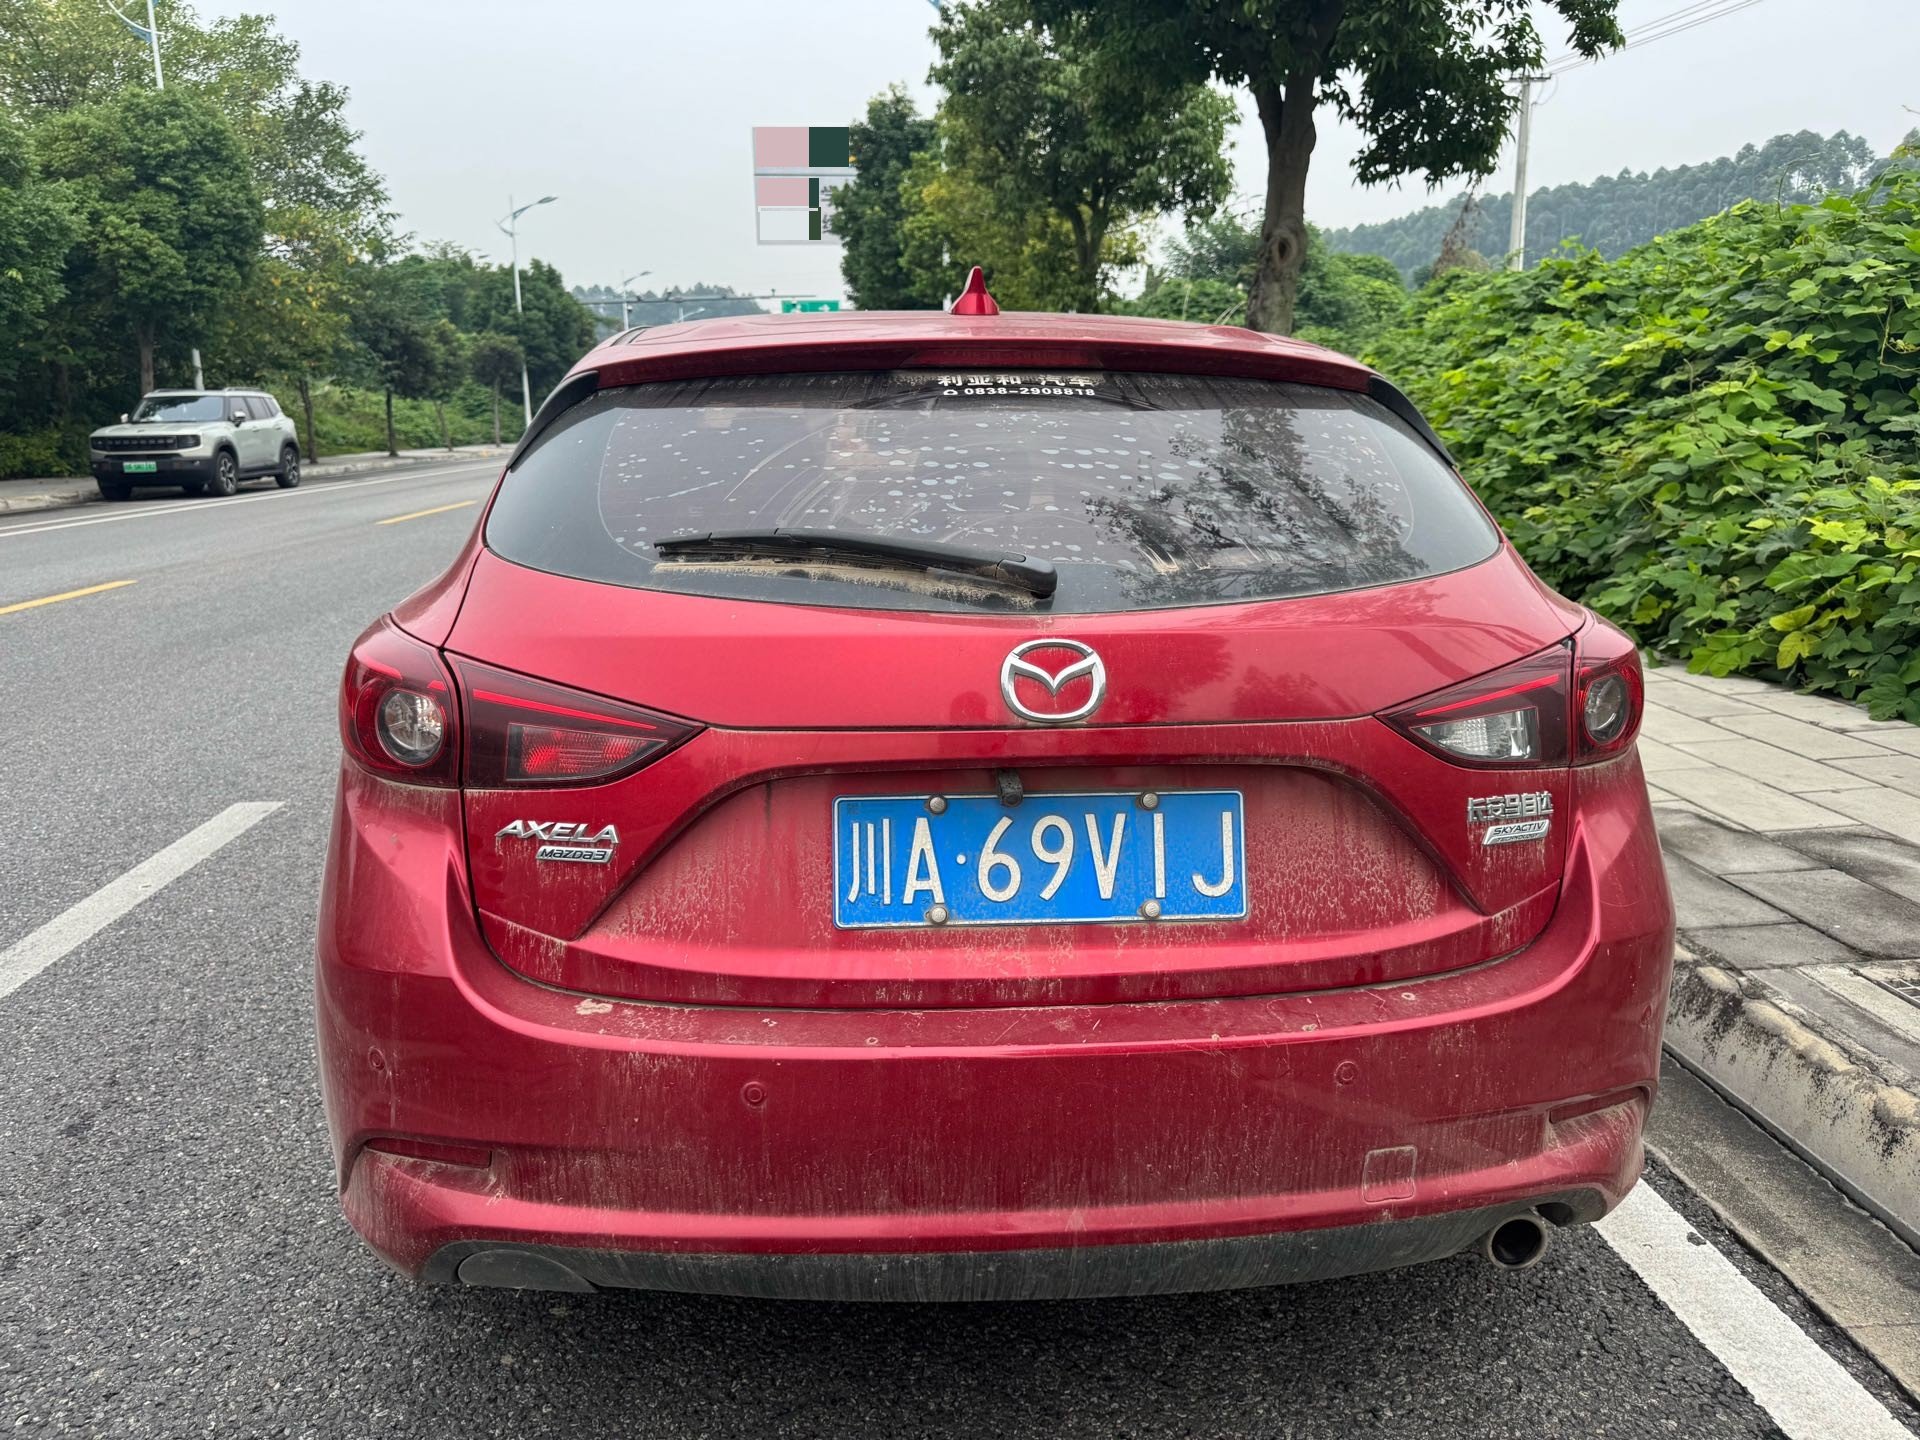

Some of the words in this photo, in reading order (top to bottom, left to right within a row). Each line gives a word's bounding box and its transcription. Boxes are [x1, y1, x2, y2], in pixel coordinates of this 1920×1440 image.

[1467, 790, 1554, 821] 长安马自达
[494, 819, 619, 844] AXELA
[1493, 821, 1545, 835] SKYACTIV
